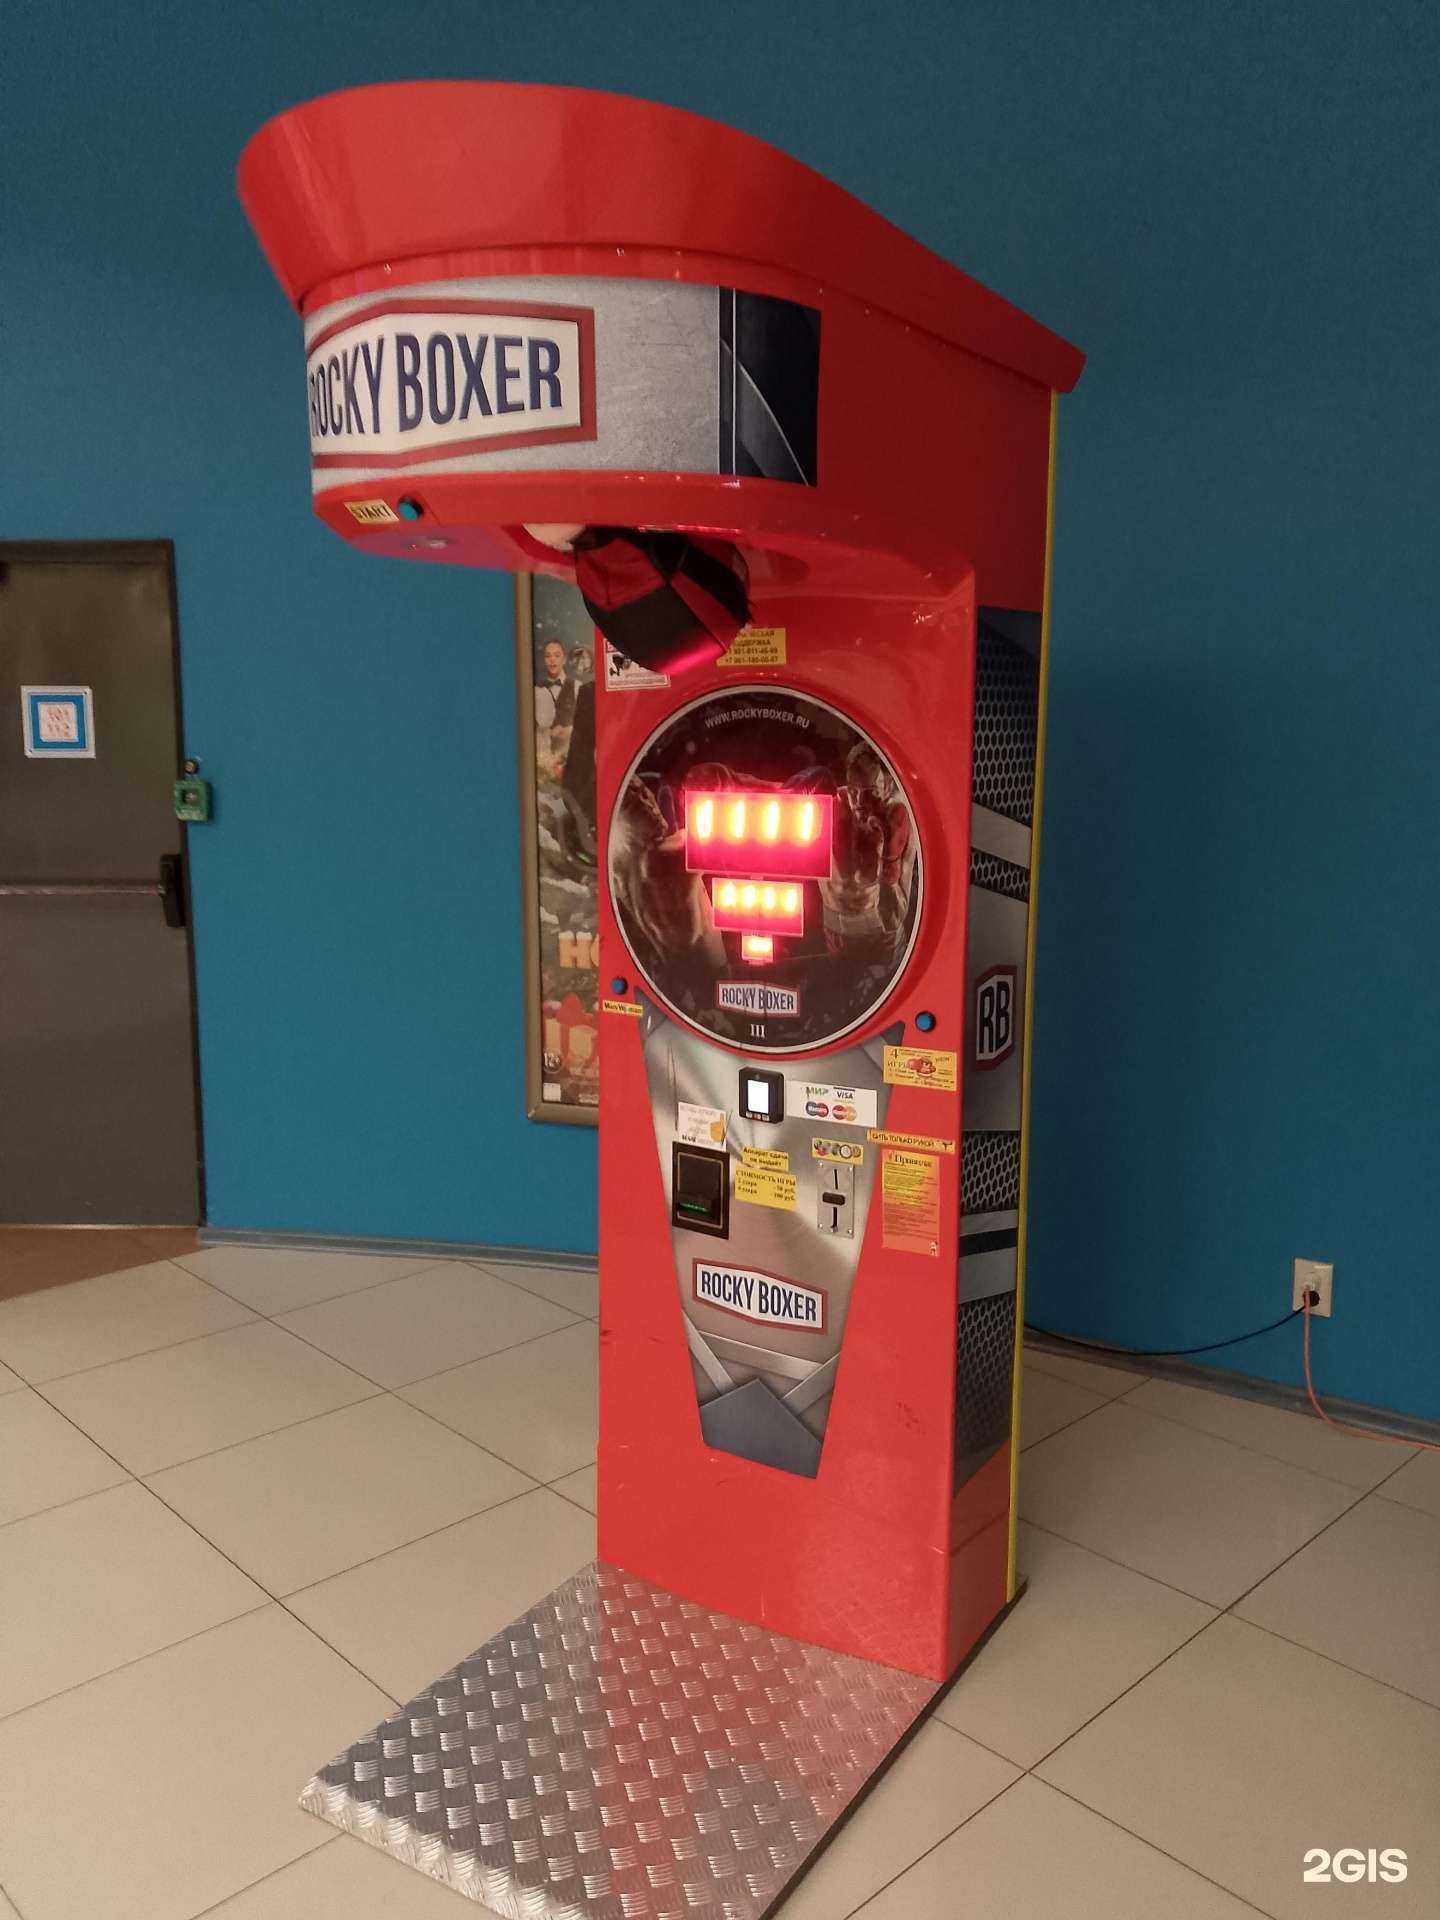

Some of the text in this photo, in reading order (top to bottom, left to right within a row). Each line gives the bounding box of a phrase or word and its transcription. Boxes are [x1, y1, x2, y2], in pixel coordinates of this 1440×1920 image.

[395, 331, 562, 432] BOXER
[705, 703, 810, 728] WWW.ROCKYBOXER.RU
[722, 986, 794, 1010] ROCKY BOXER
[978, 980, 1011, 1054] RB
[836, 1091, 854, 1100] VISA
[701, 1270, 817, 1322] ROCKY BOXER
